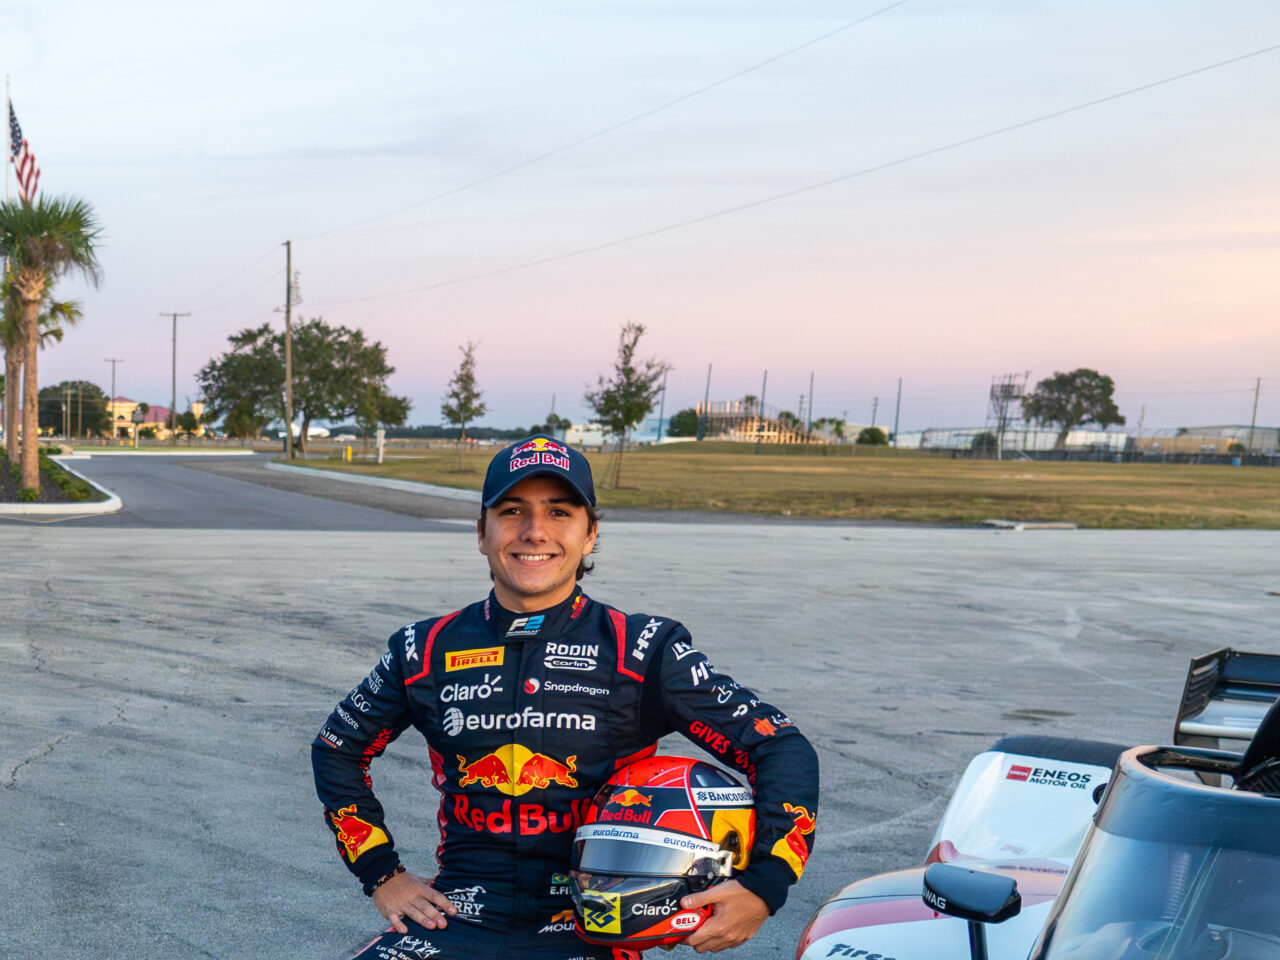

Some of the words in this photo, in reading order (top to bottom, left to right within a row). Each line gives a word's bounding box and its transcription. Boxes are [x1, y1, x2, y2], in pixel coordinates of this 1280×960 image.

[510, 452, 540, 472] Red
[542, 452, 570, 471] Bull
[508, 615, 545, 631] F2
[403, 623, 419, 662] HRX
[632, 617, 663, 662] HRX
[545, 642, 600, 657] RODIN
[450, 650, 500, 668] PIRELLI
[551, 659, 589, 668] carlin
[440, 674, 503, 703] Claro
[543, 681, 611, 696] Snapdragon
[466, 706, 597, 731] eurofarma
[689, 720, 732, 755] GIVES
[1032, 767, 1092, 783] ENEOS
[1029, 777, 1068, 788] MOTOR
[1070, 781, 1087, 790] OIL
[451, 793, 512, 833] Red
[599, 809, 622, 822] Red
[622, 809, 652, 824] Bull
[592, 828, 639, 839] eurofarma
[631, 899, 678, 916] Claro
[675, 915, 697, 926] BELL
[379, 952, 390, 960] ao
[387, 948, 398, 956] de
